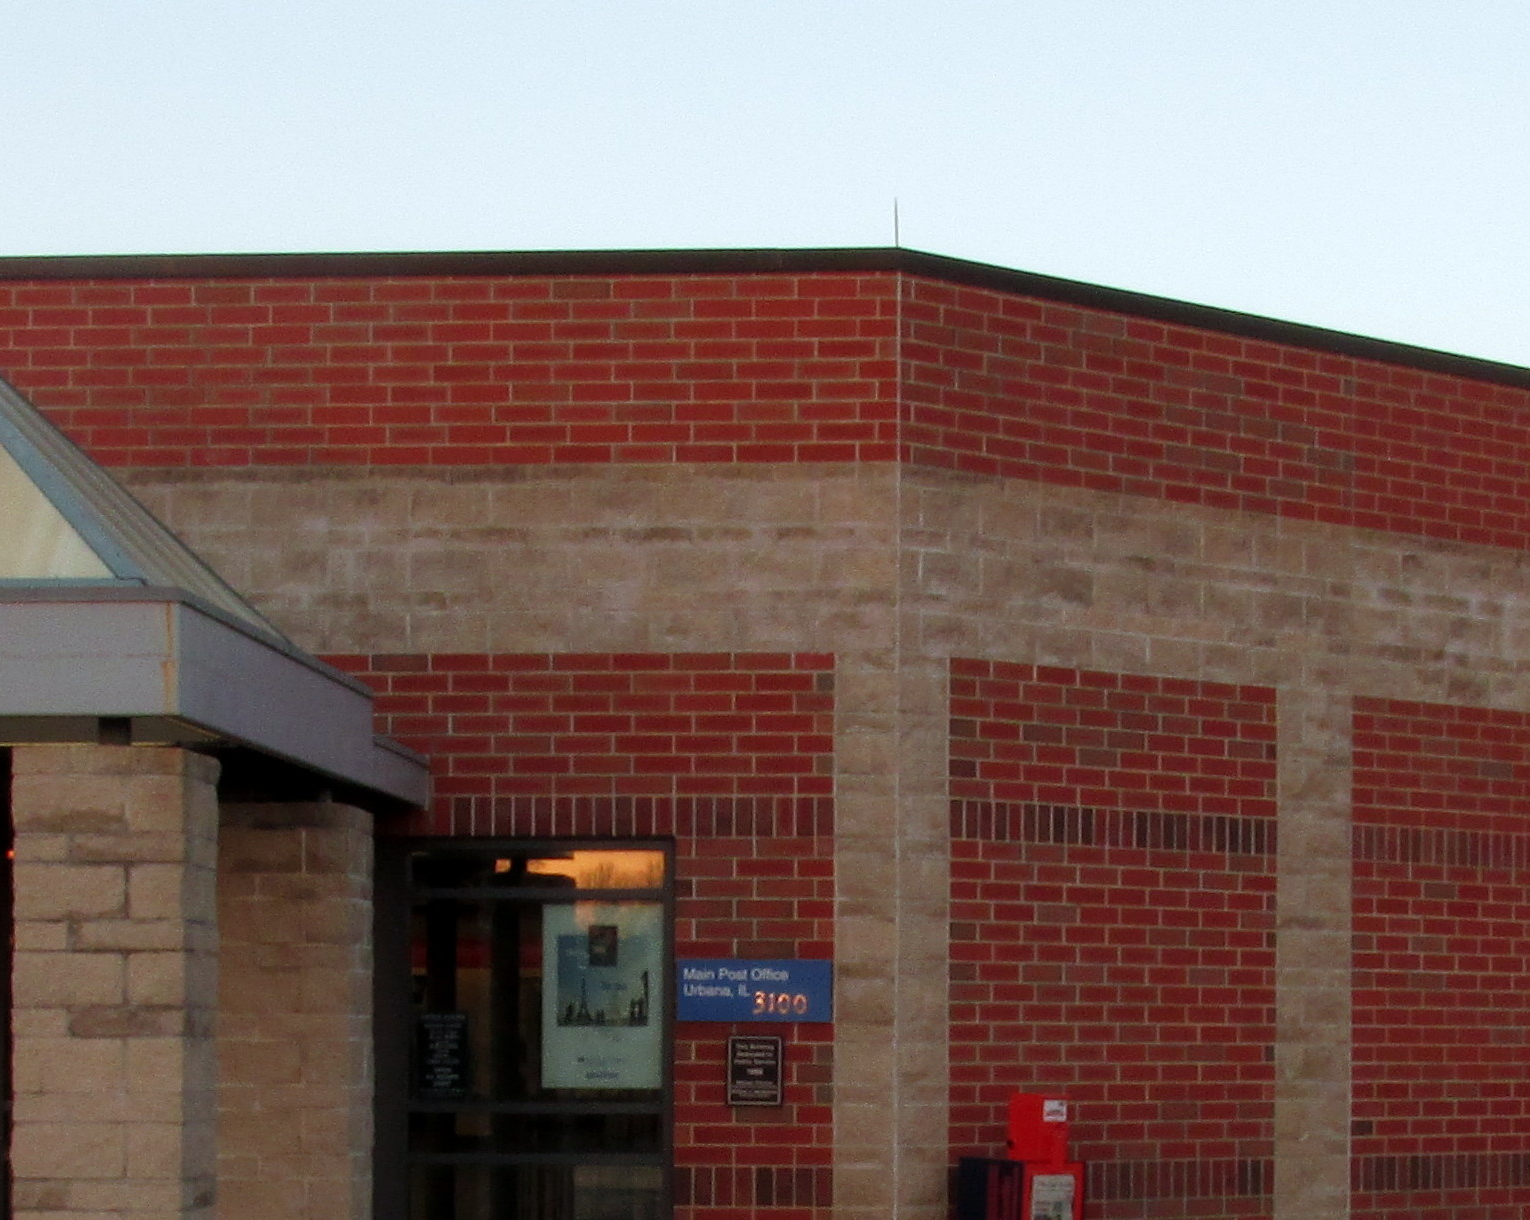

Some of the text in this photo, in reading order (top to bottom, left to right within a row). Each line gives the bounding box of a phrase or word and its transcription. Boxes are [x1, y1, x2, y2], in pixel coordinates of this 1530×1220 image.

[683, 967, 789, 981] Main Post Office
[738, 983, 750, 997] IL
[753, 989, 808, 1015] 3100
